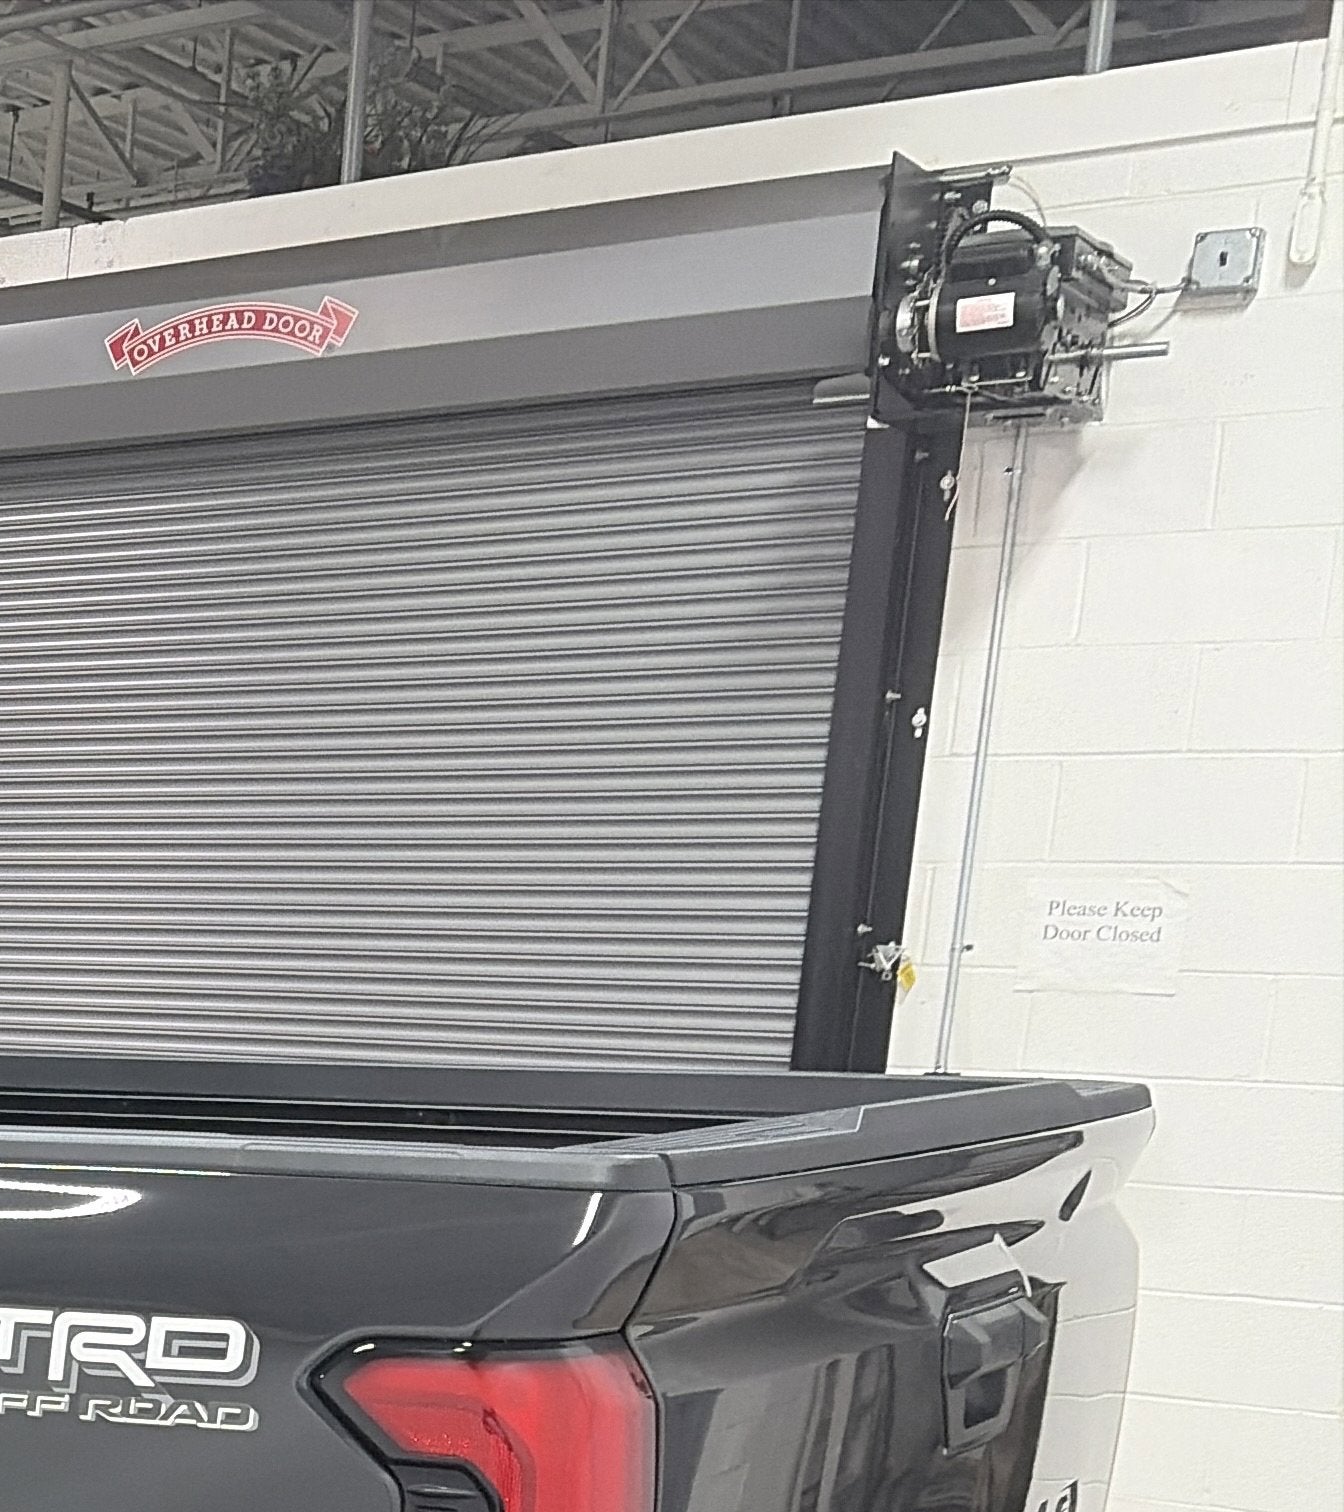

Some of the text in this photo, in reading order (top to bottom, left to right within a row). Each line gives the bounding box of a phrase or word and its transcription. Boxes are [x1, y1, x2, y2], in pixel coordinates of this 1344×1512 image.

[132, 310, 324, 362] OVERHEAD DOOR
[1047, 899, 1164, 922] Please Keep
[1042, 924, 1162, 943] Door Closed
[78, 1396, 260, 1432] ROAD
